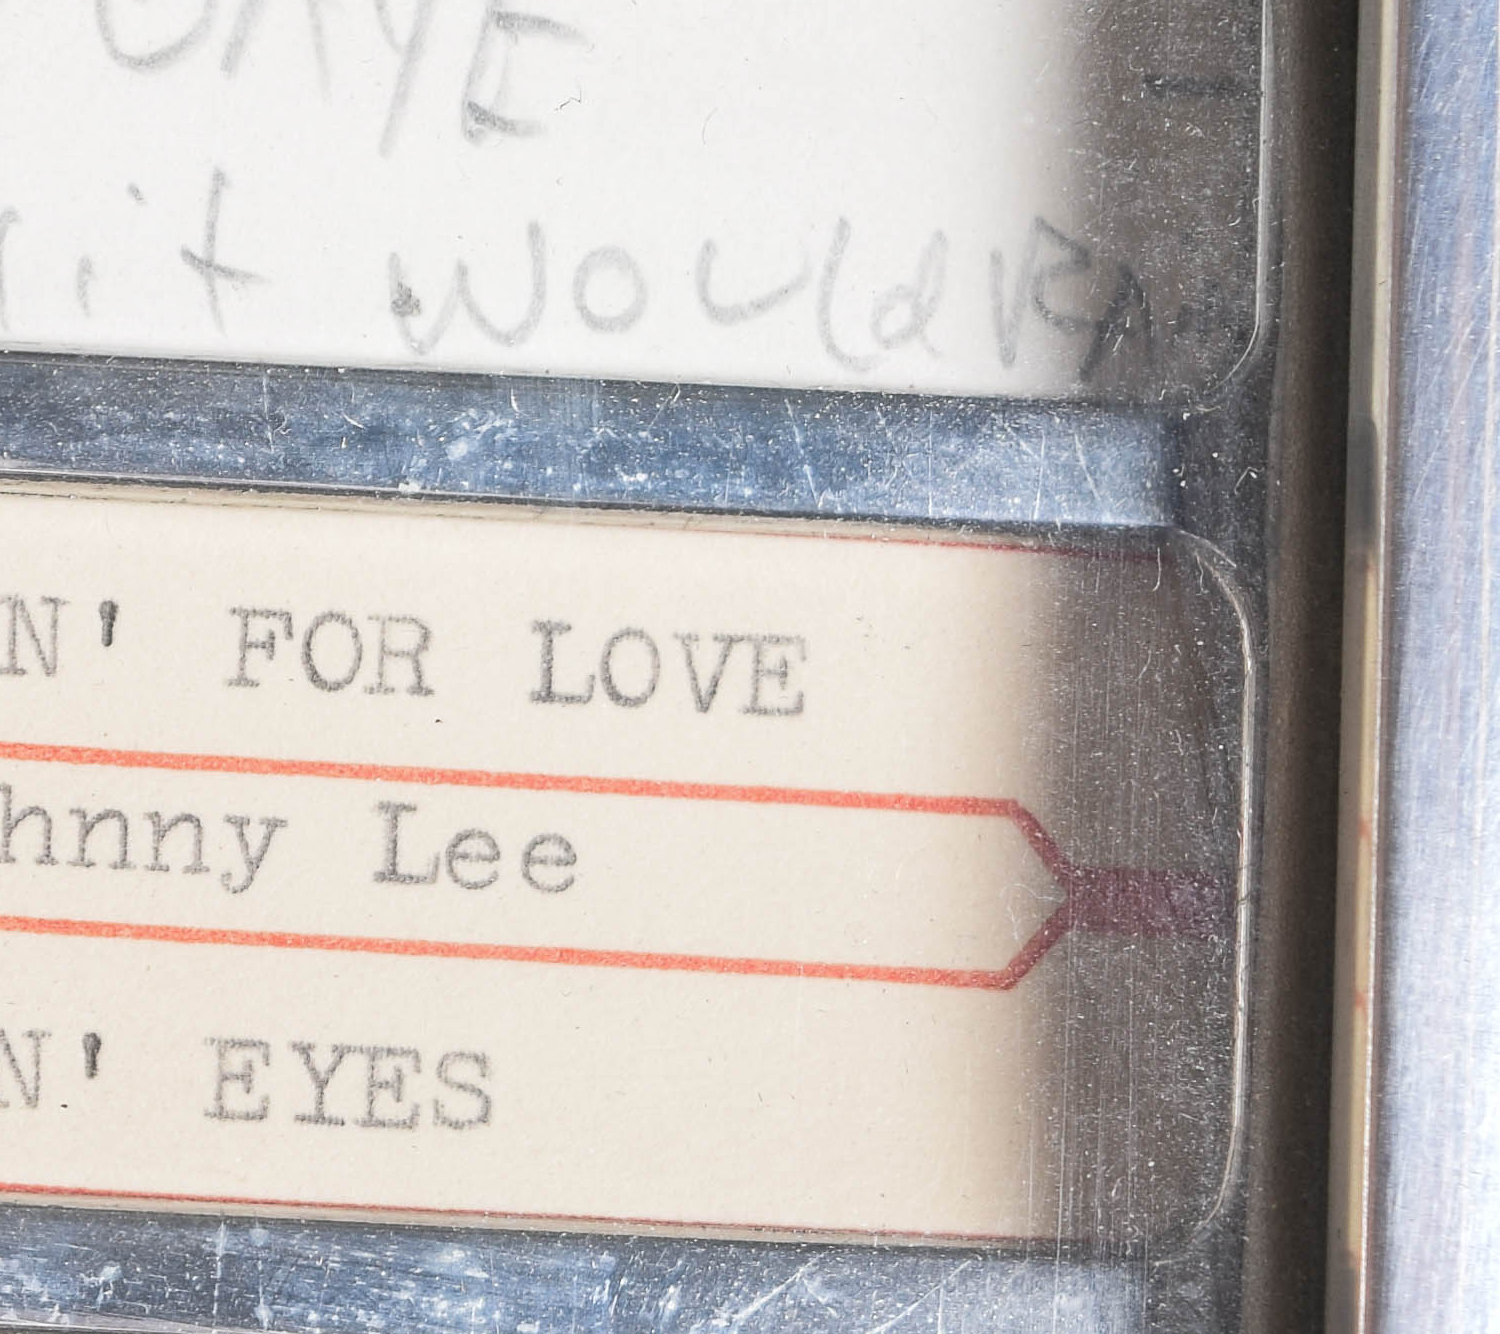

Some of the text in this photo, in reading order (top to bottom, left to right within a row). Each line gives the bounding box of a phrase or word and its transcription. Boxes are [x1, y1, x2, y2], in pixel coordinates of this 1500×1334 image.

[234, 607, 435, 698] FOR
[530, 619, 805, 717] LOVE
[374, 801, 578, 894] Lee
[210, 1038, 492, 1131] EYES
